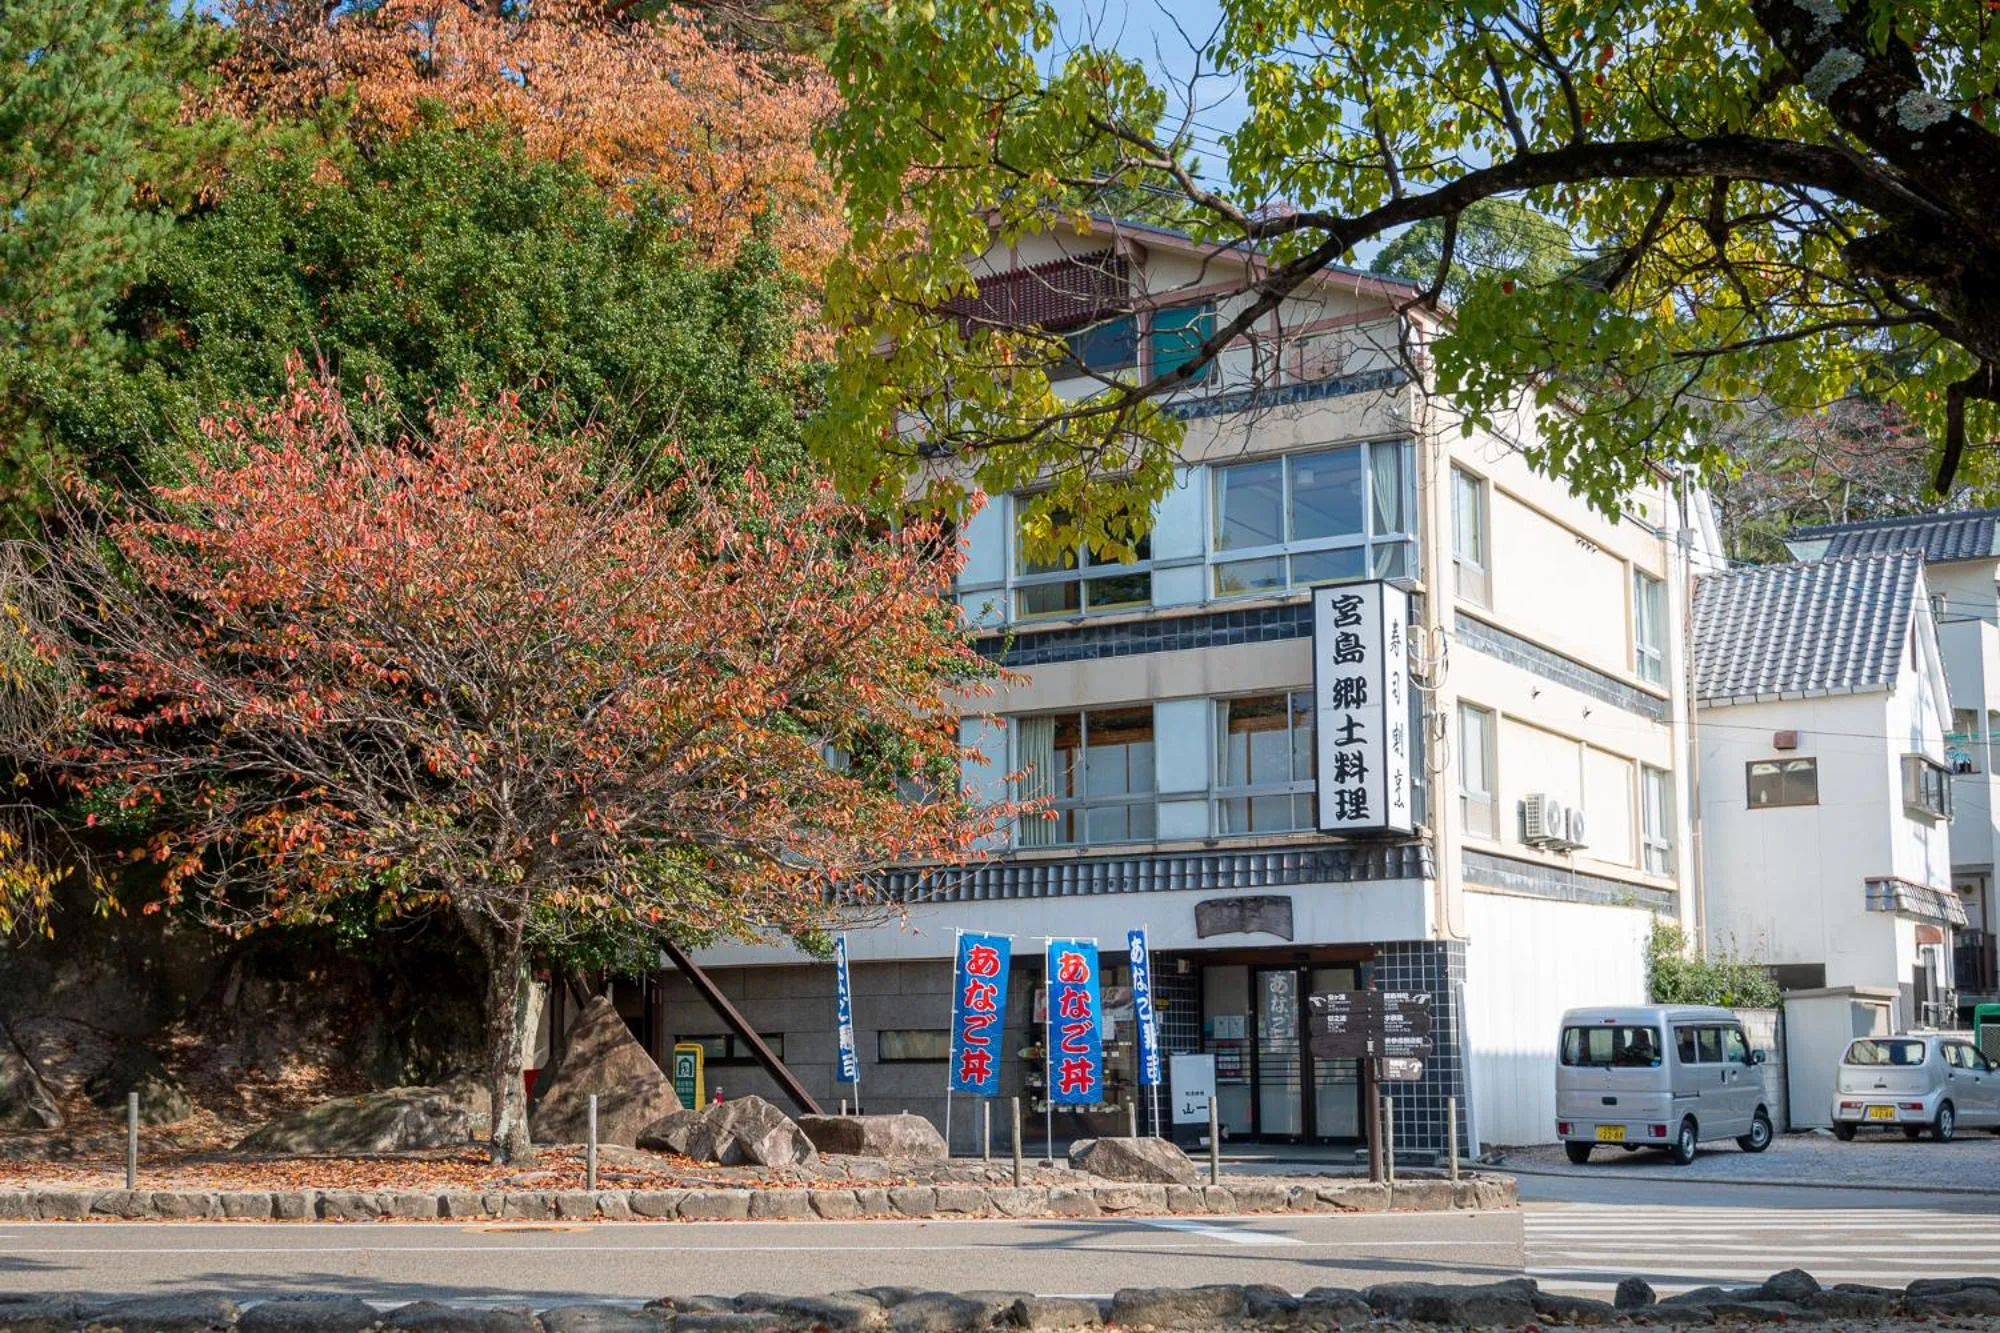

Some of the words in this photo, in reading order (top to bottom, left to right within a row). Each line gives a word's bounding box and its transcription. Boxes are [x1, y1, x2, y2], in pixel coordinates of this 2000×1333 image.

[1332, 593, 1370, 821] 宮島郷土料理
[960, 943, 1001, 1085] あなご丼
[1058, 951, 1095, 1095] あなご丼
[1182, 1102, 1207, 1115] 山一
